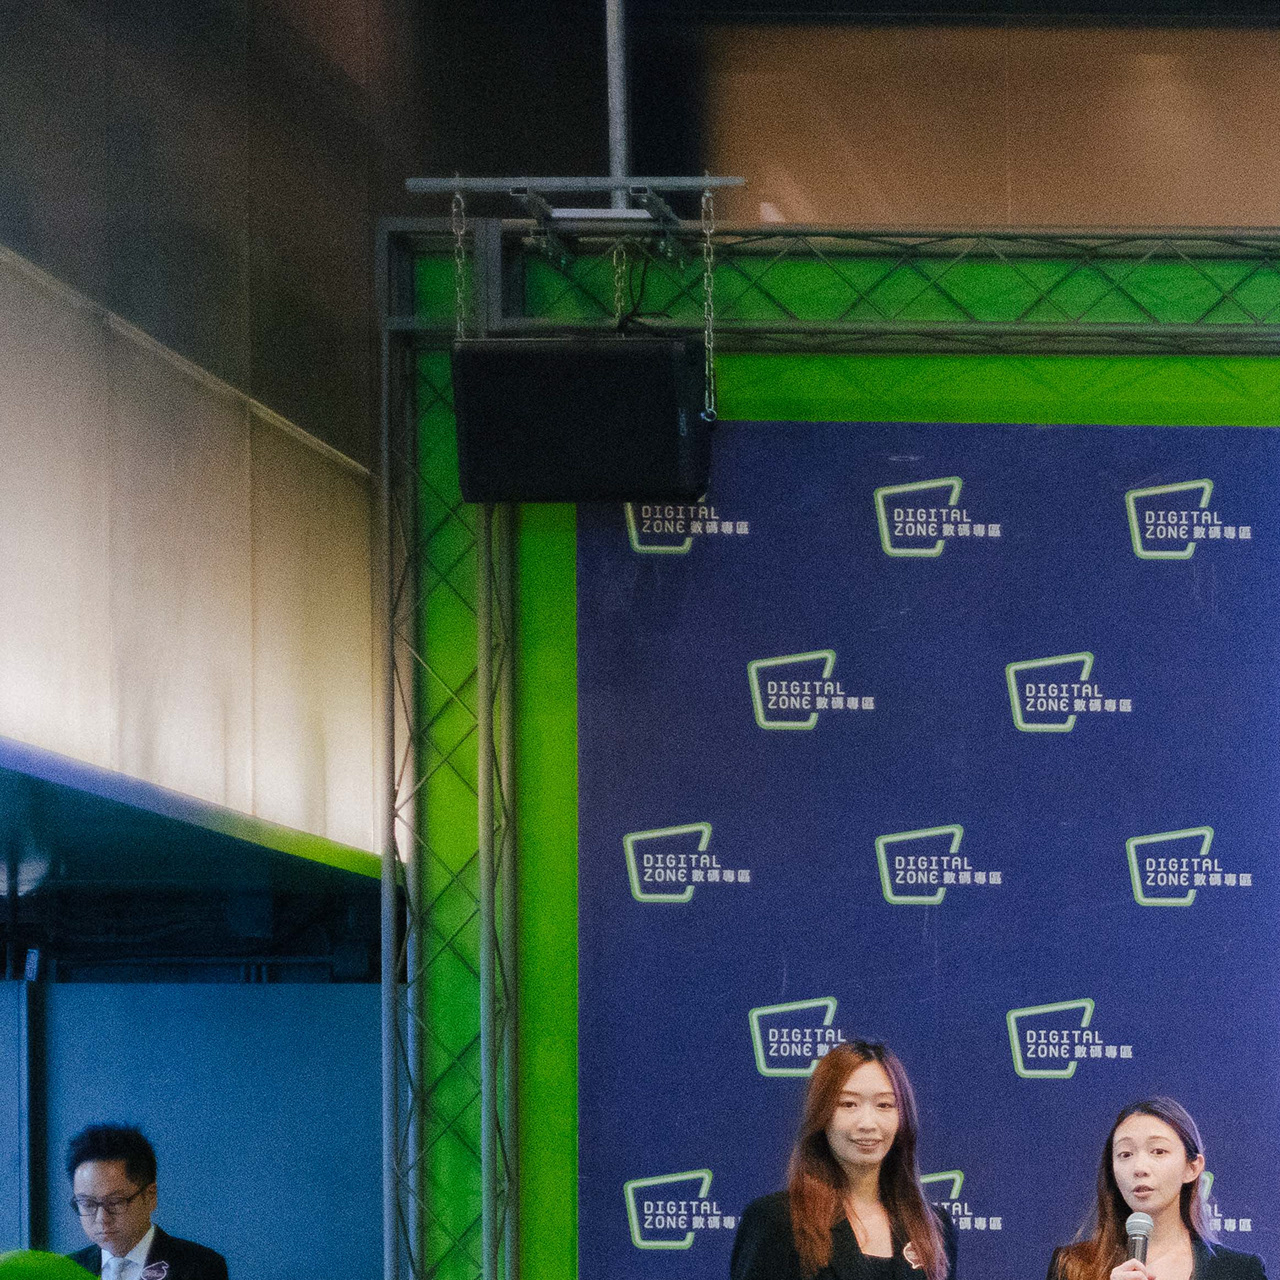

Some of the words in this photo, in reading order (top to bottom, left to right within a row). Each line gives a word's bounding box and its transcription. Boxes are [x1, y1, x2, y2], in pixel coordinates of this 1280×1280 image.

[641, 505, 720, 519] DIGITAL
[893, 508, 972, 522] DIGITAL
[1144, 510, 1223, 524] DIGITAL
[641, 520, 687, 534] ZONE
[893, 523, 939, 537] ZONE
[1144, 525, 1190, 539] ZONE
[767, 681, 846, 695] DIGITAL
[1024, 683, 1103, 697] DIGITAL
[767, 696, 813, 710] ZONE
[1024, 698, 1070, 712] ZONE
[642, 854, 721, 868] DIGITAL
[894, 856, 973, 870] DIGITAL
[1145, 858, 1224, 872] DIGITAL
[642, 869, 688, 883] ZONE
[894, 871, 940, 885] ZONE
[1145, 873, 1191, 887] ZONE
[768, 1028, 847, 1042] DIGITAL
[1025, 1030, 1104, 1044] DIGITAL
[768, 1043, 814, 1057] ZONE
[1025, 1045, 1071, 1059] ZONE
[643, 1200, 722, 1214] DIGITAL
[643, 1215, 689, 1229] ZONE
[692, 1215, 741, 1230] 數碼專
[952, 1217, 1003, 1231] 碼專區
